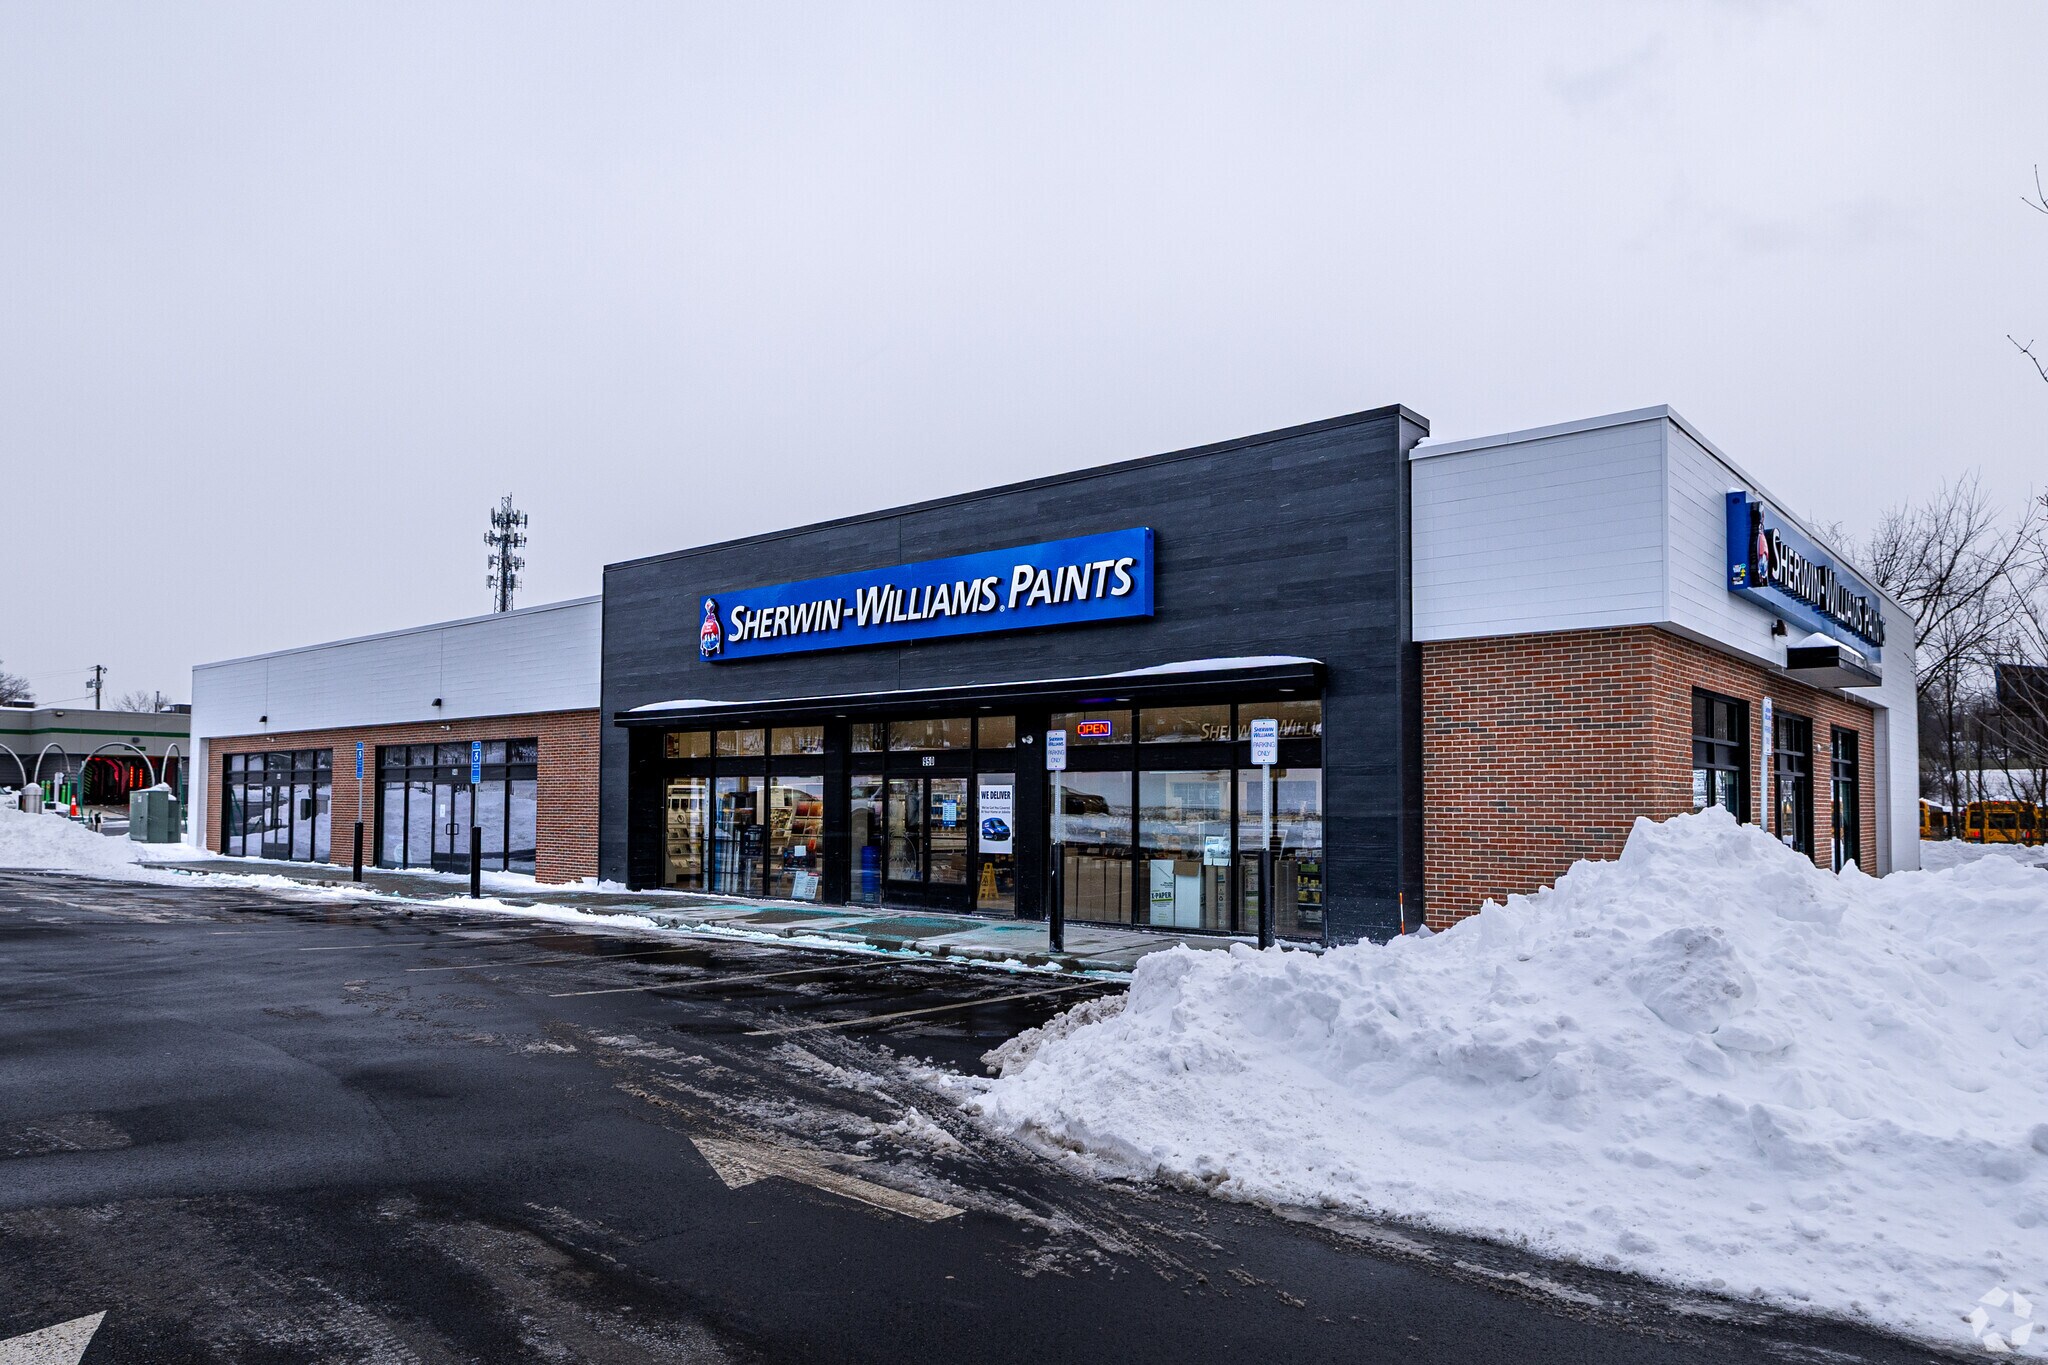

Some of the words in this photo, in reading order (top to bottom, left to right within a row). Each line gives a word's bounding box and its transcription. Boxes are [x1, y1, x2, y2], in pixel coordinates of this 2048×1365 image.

[727, 575, 999, 643] SHERWIN-WILLIAMS
[1007, 556, 1136, 609] PAINTS
[1772, 527, 1863, 632] SHERWIN-WILLIAMS
[1077, 724, 1108, 735] OPEN
[981, 790, 989, 800] WE
[990, 790, 1011, 800] DELIVER
